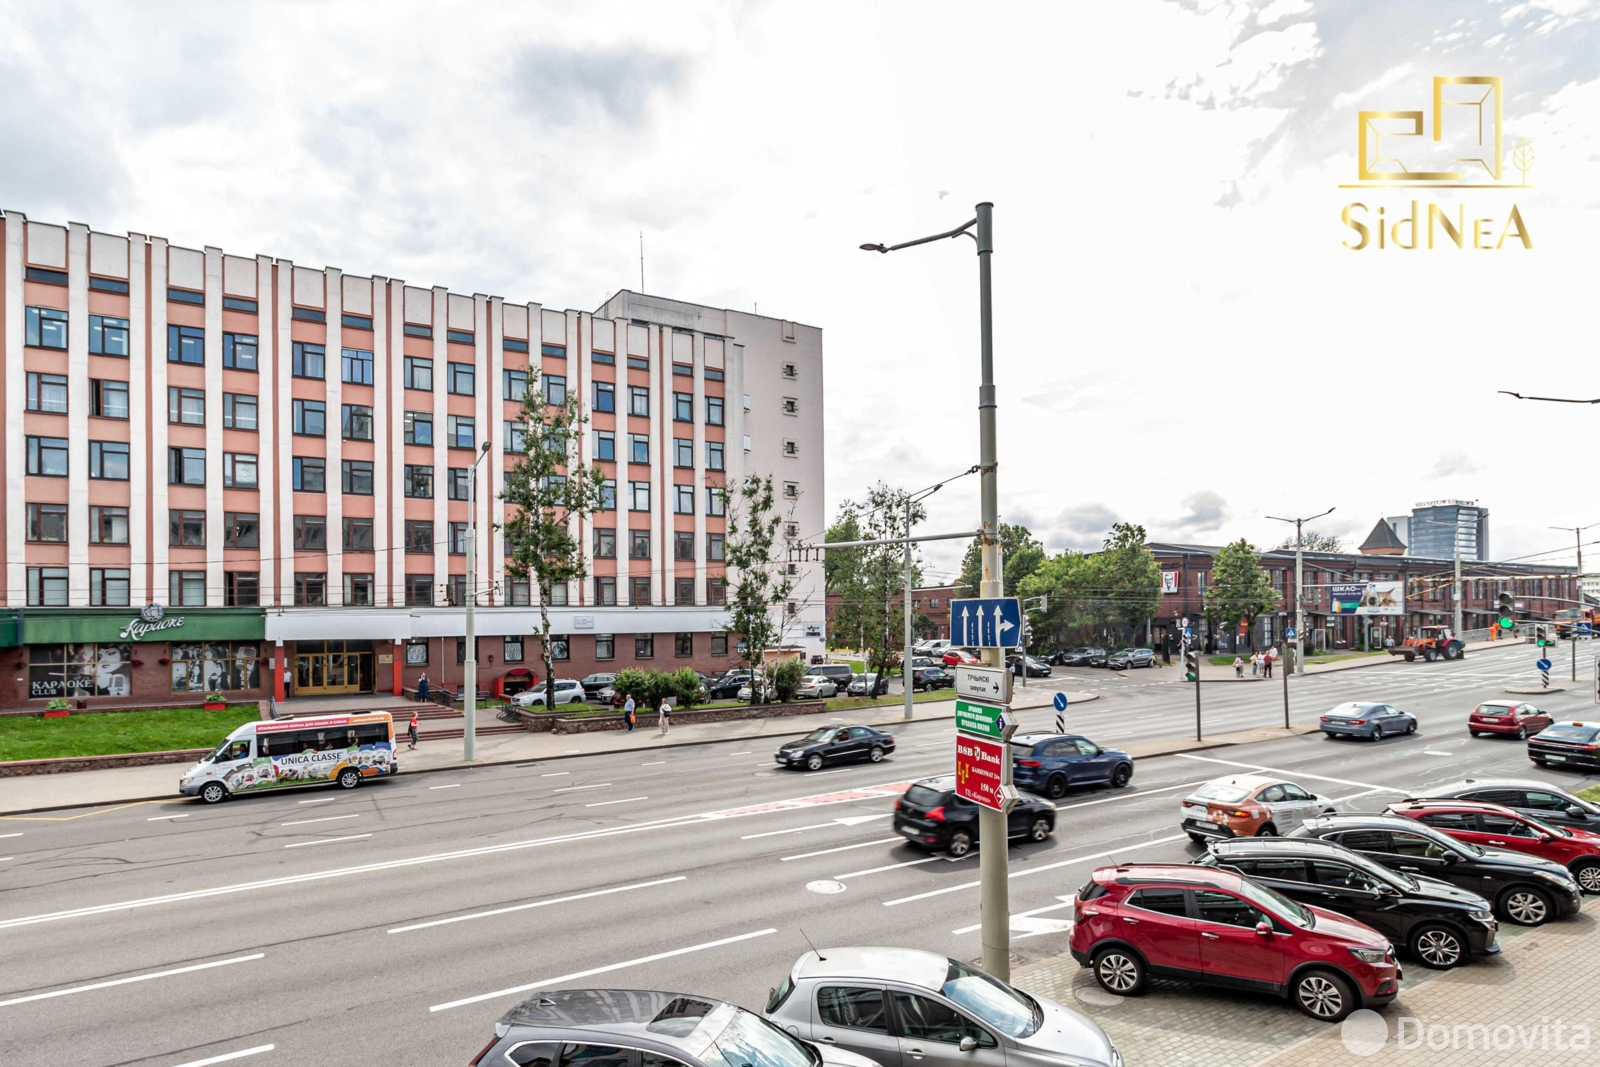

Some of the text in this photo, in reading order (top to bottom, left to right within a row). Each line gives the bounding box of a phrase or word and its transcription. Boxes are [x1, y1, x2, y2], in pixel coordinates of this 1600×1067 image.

[32, 688, 57, 696] CLUB
[281, 752, 342, 765] UNICA CLASSE
[957, 744, 1001, 765] BSB Bank
[980, 782, 989, 792] 150
